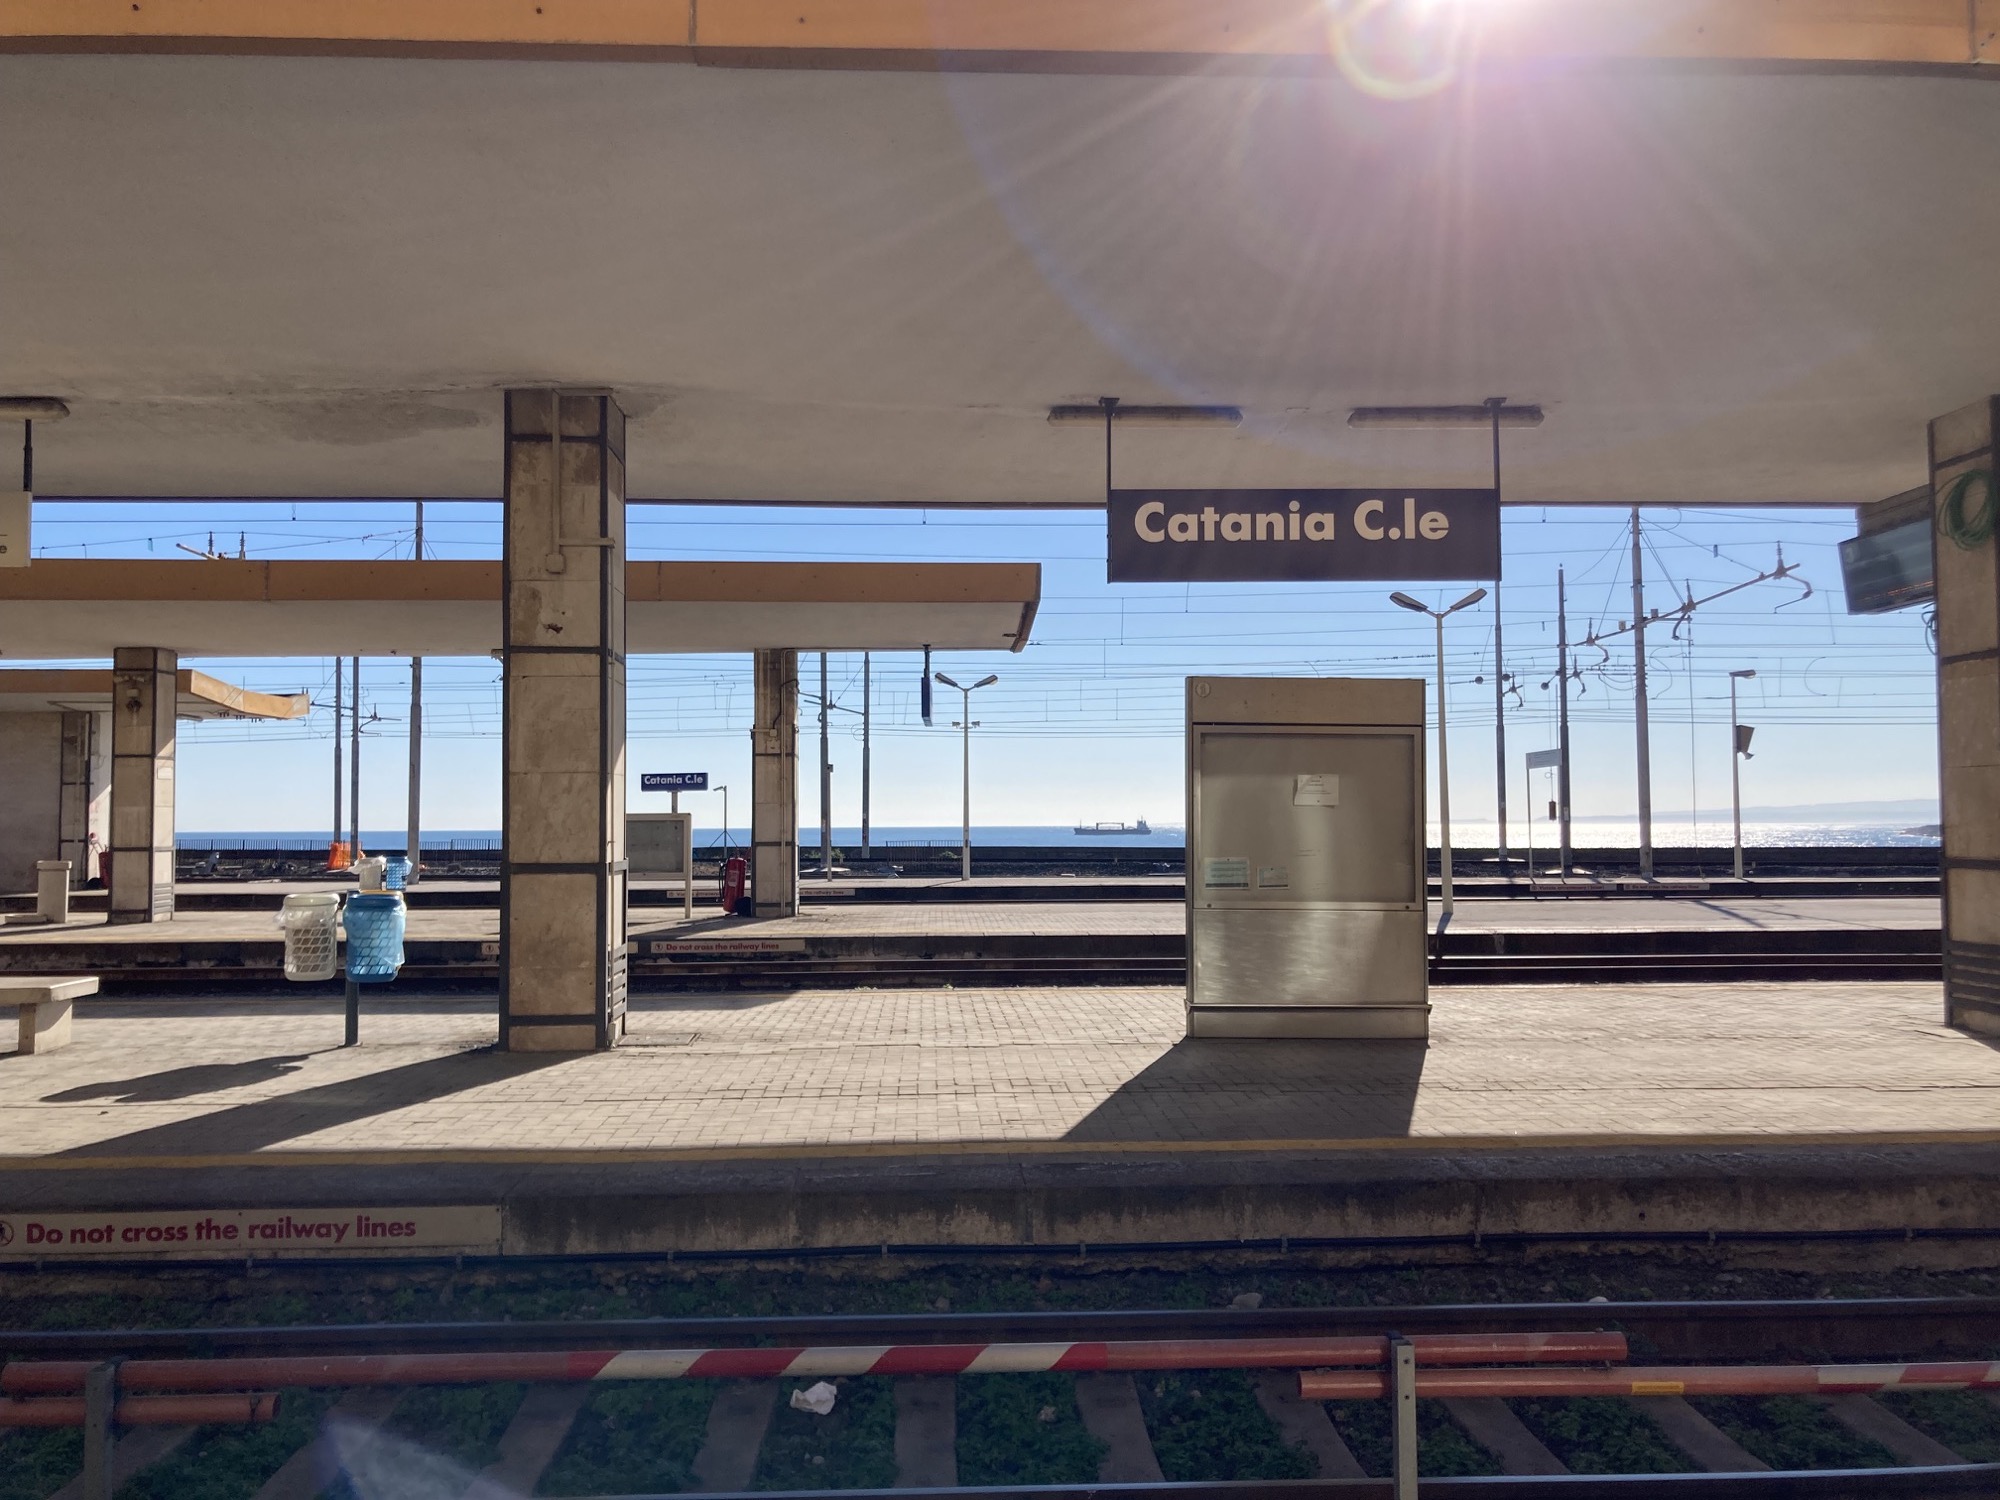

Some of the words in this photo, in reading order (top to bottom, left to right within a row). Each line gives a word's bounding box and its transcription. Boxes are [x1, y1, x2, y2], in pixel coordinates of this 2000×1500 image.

[1134, 500, 1335, 543] Catania
[1353, 498, 1450, 541] C.le
[644, 775, 683, 785] Catania
[685, 774, 704, 784] C.le
[666, 943, 677, 951] Do
[679, 943, 692, 951] not
[729, 943, 760, 951] railway
[26, 1223, 63, 1244] Do
[70, 1224, 115, 1244] not
[121, 1224, 188, 1243] cross
[195, 1217, 239, 1240] the
[248, 1216, 350, 1243] railway
[356, 1215, 416, 1238] lines
